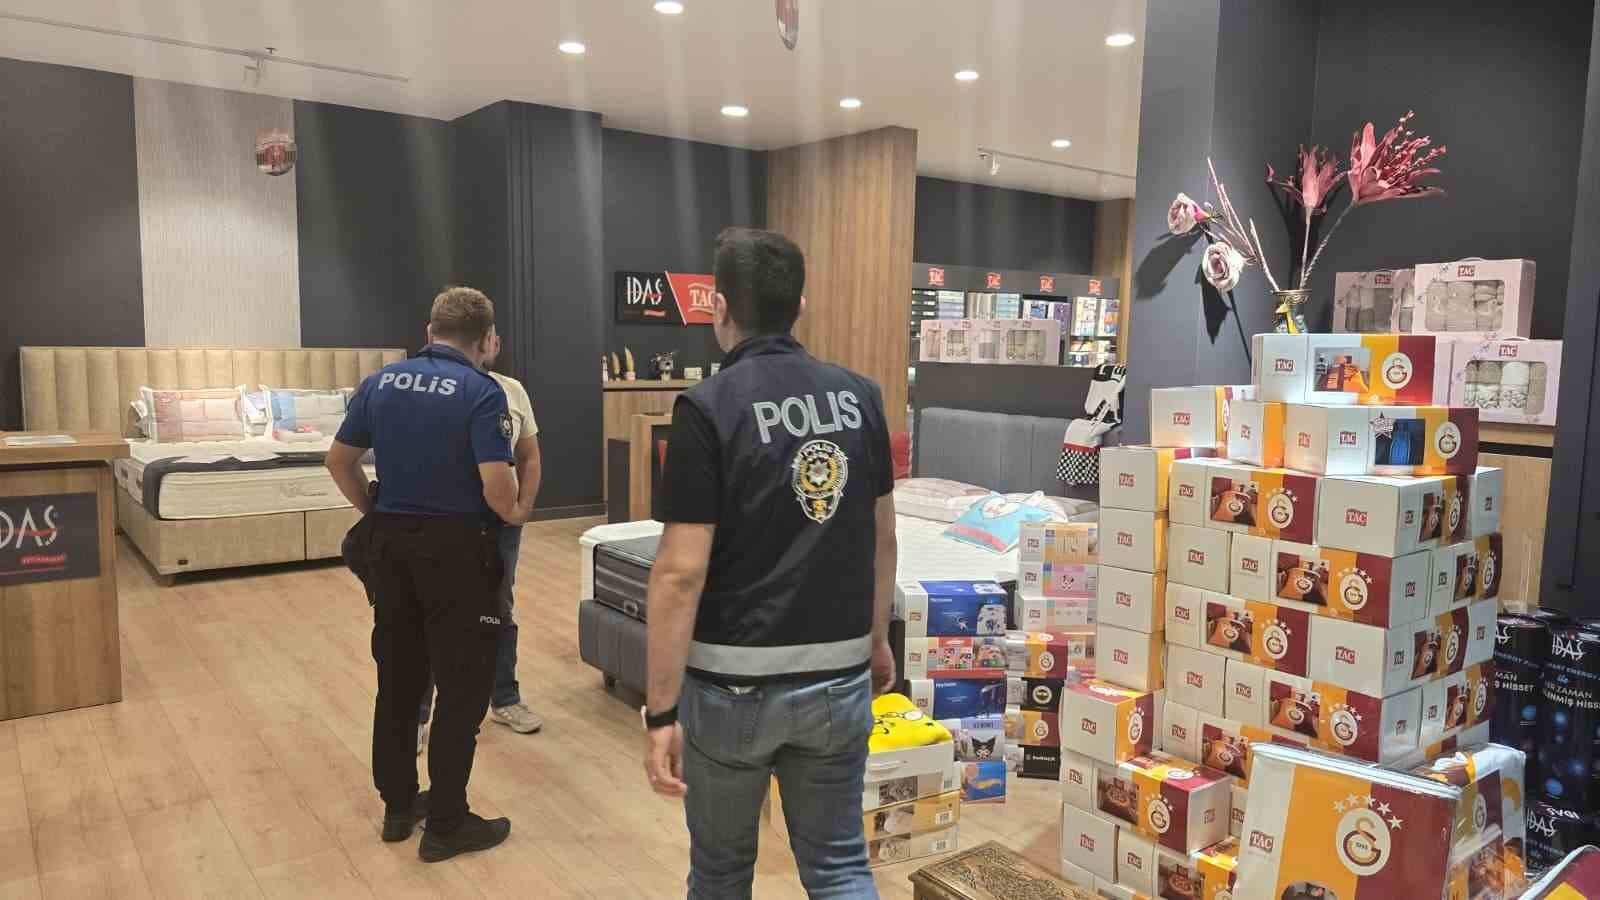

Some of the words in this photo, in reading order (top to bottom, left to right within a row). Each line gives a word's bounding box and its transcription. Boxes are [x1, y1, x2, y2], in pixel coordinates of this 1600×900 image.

[752, 391, 863, 444] POLIS
[1337, 650, 1354, 662] TAC
[1251, 834, 1272, 850] TAC
